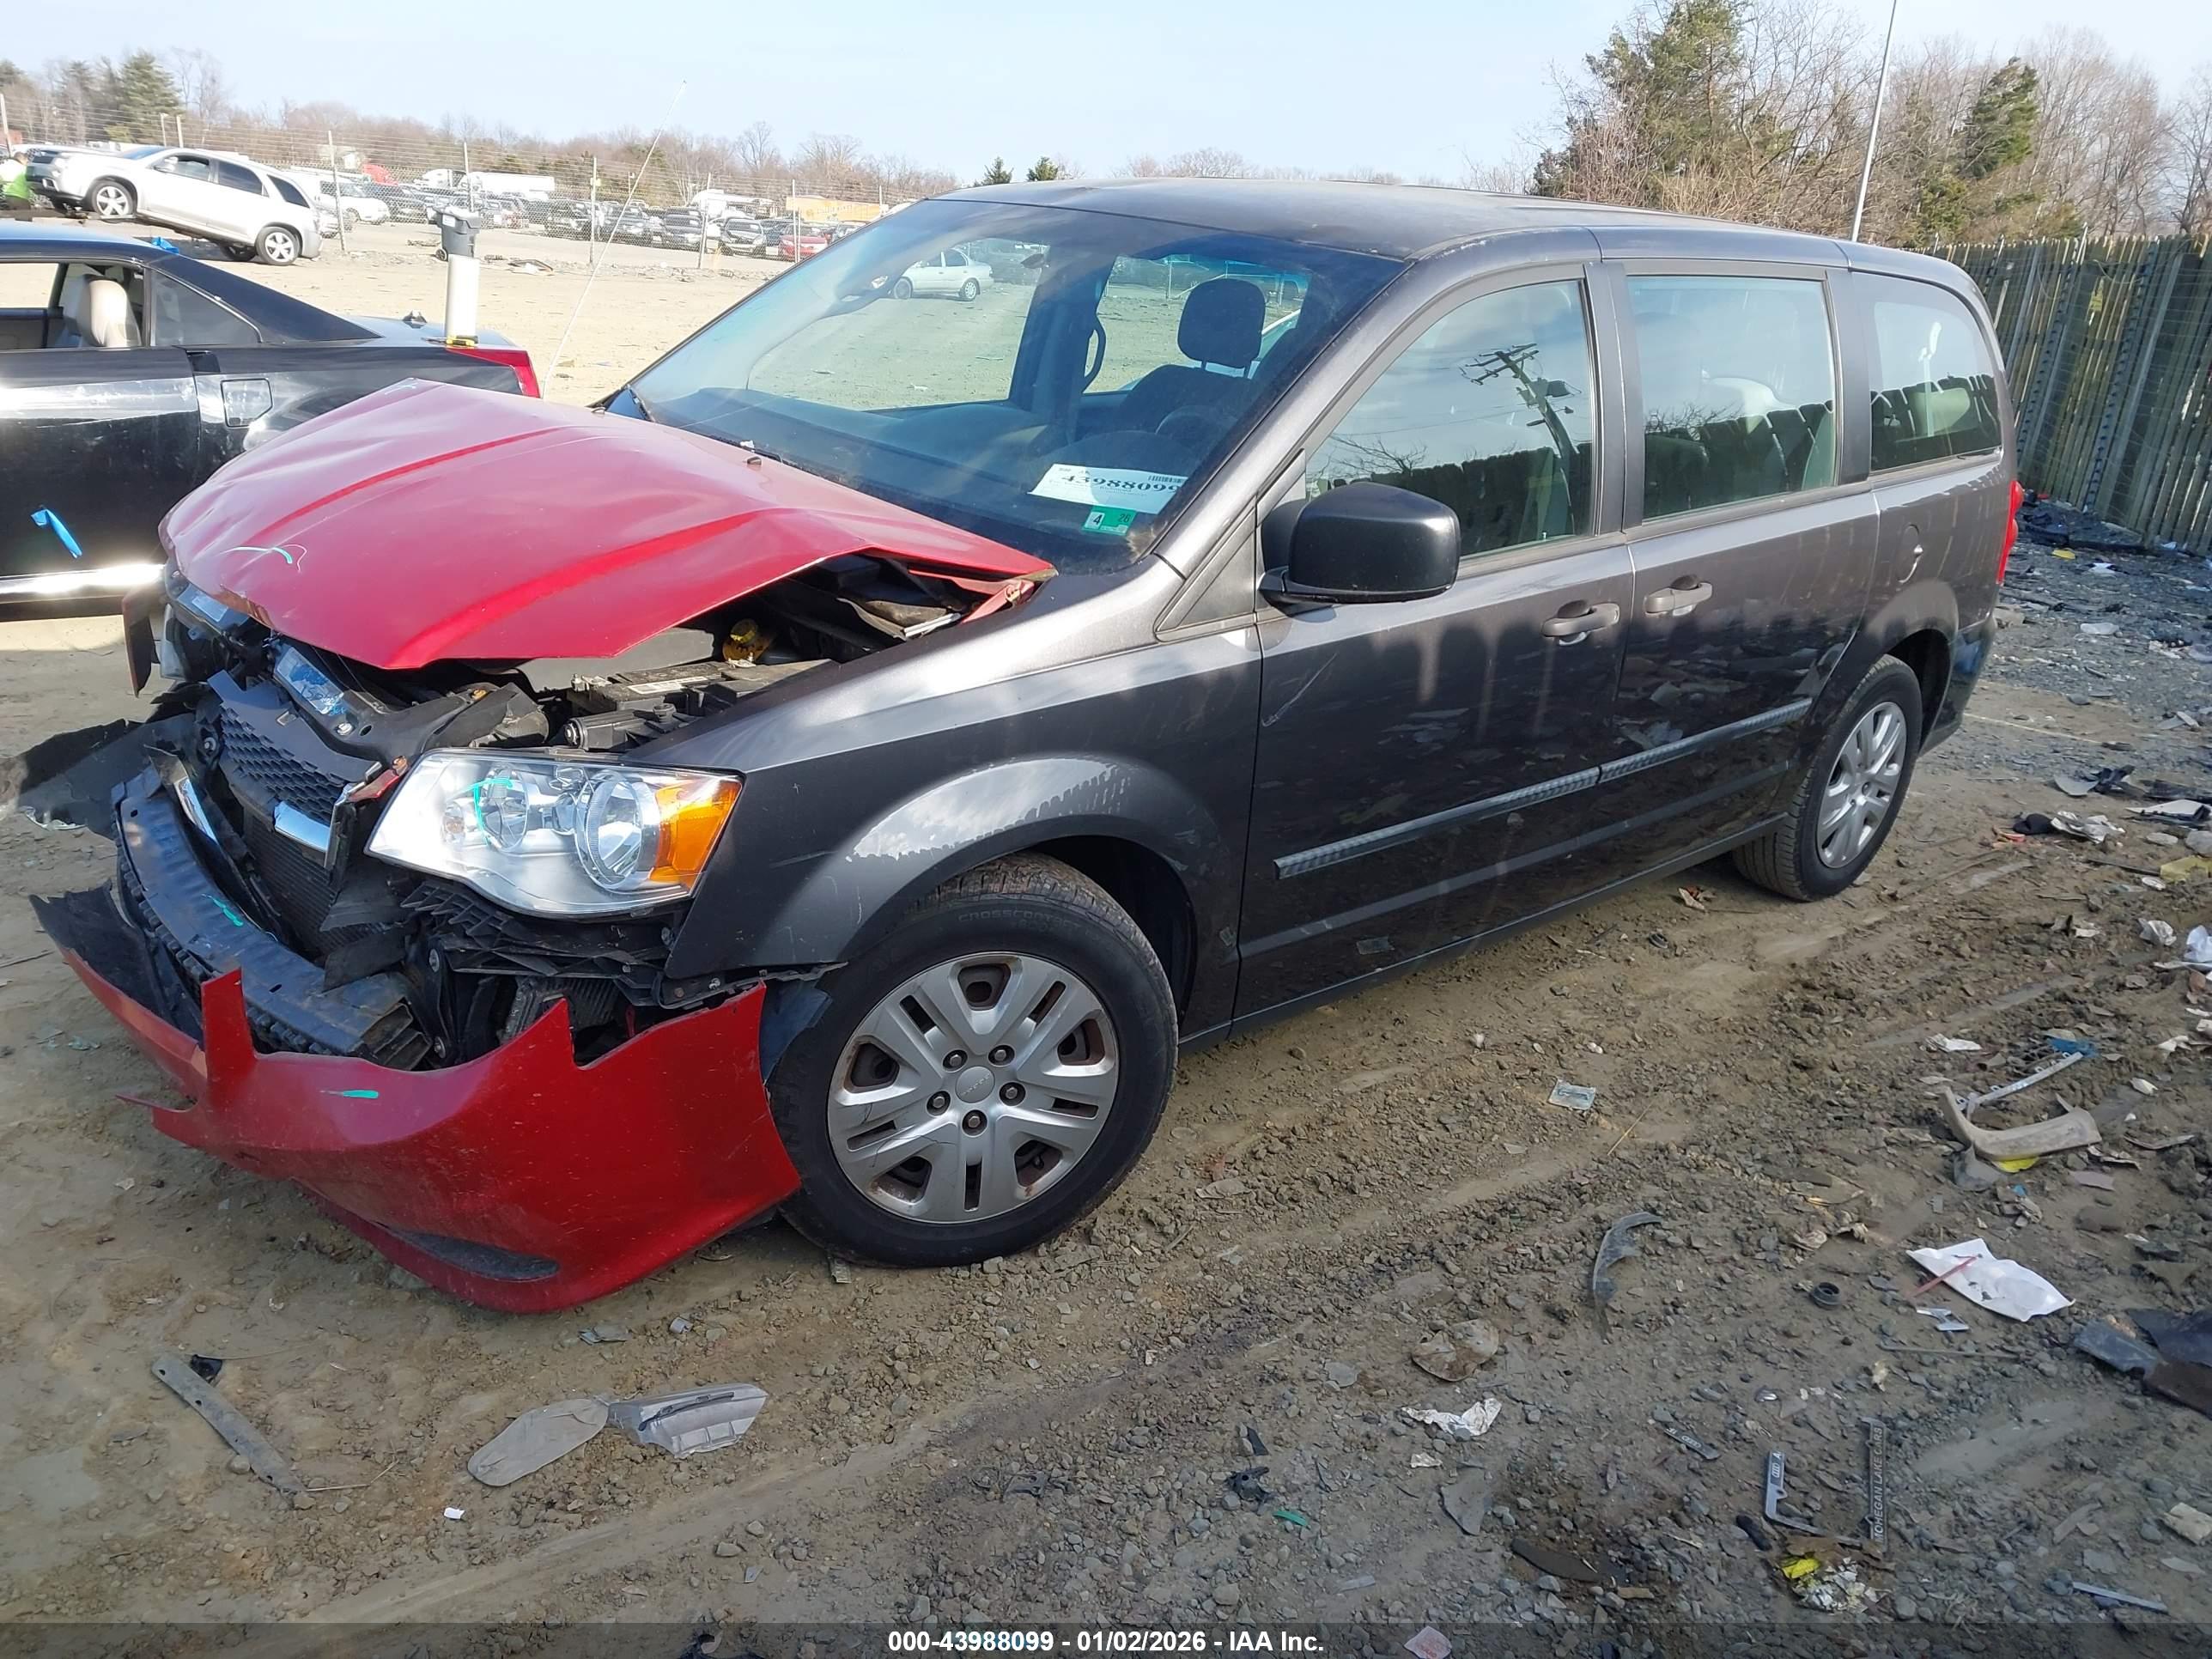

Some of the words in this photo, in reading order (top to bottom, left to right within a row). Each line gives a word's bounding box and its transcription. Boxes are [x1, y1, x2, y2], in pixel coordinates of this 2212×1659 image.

[1092, 514, 1103, 526] 4
[1874, 1427, 1883, 1455] CARS
[1874, 1458, 1883, 1485] LAKE
